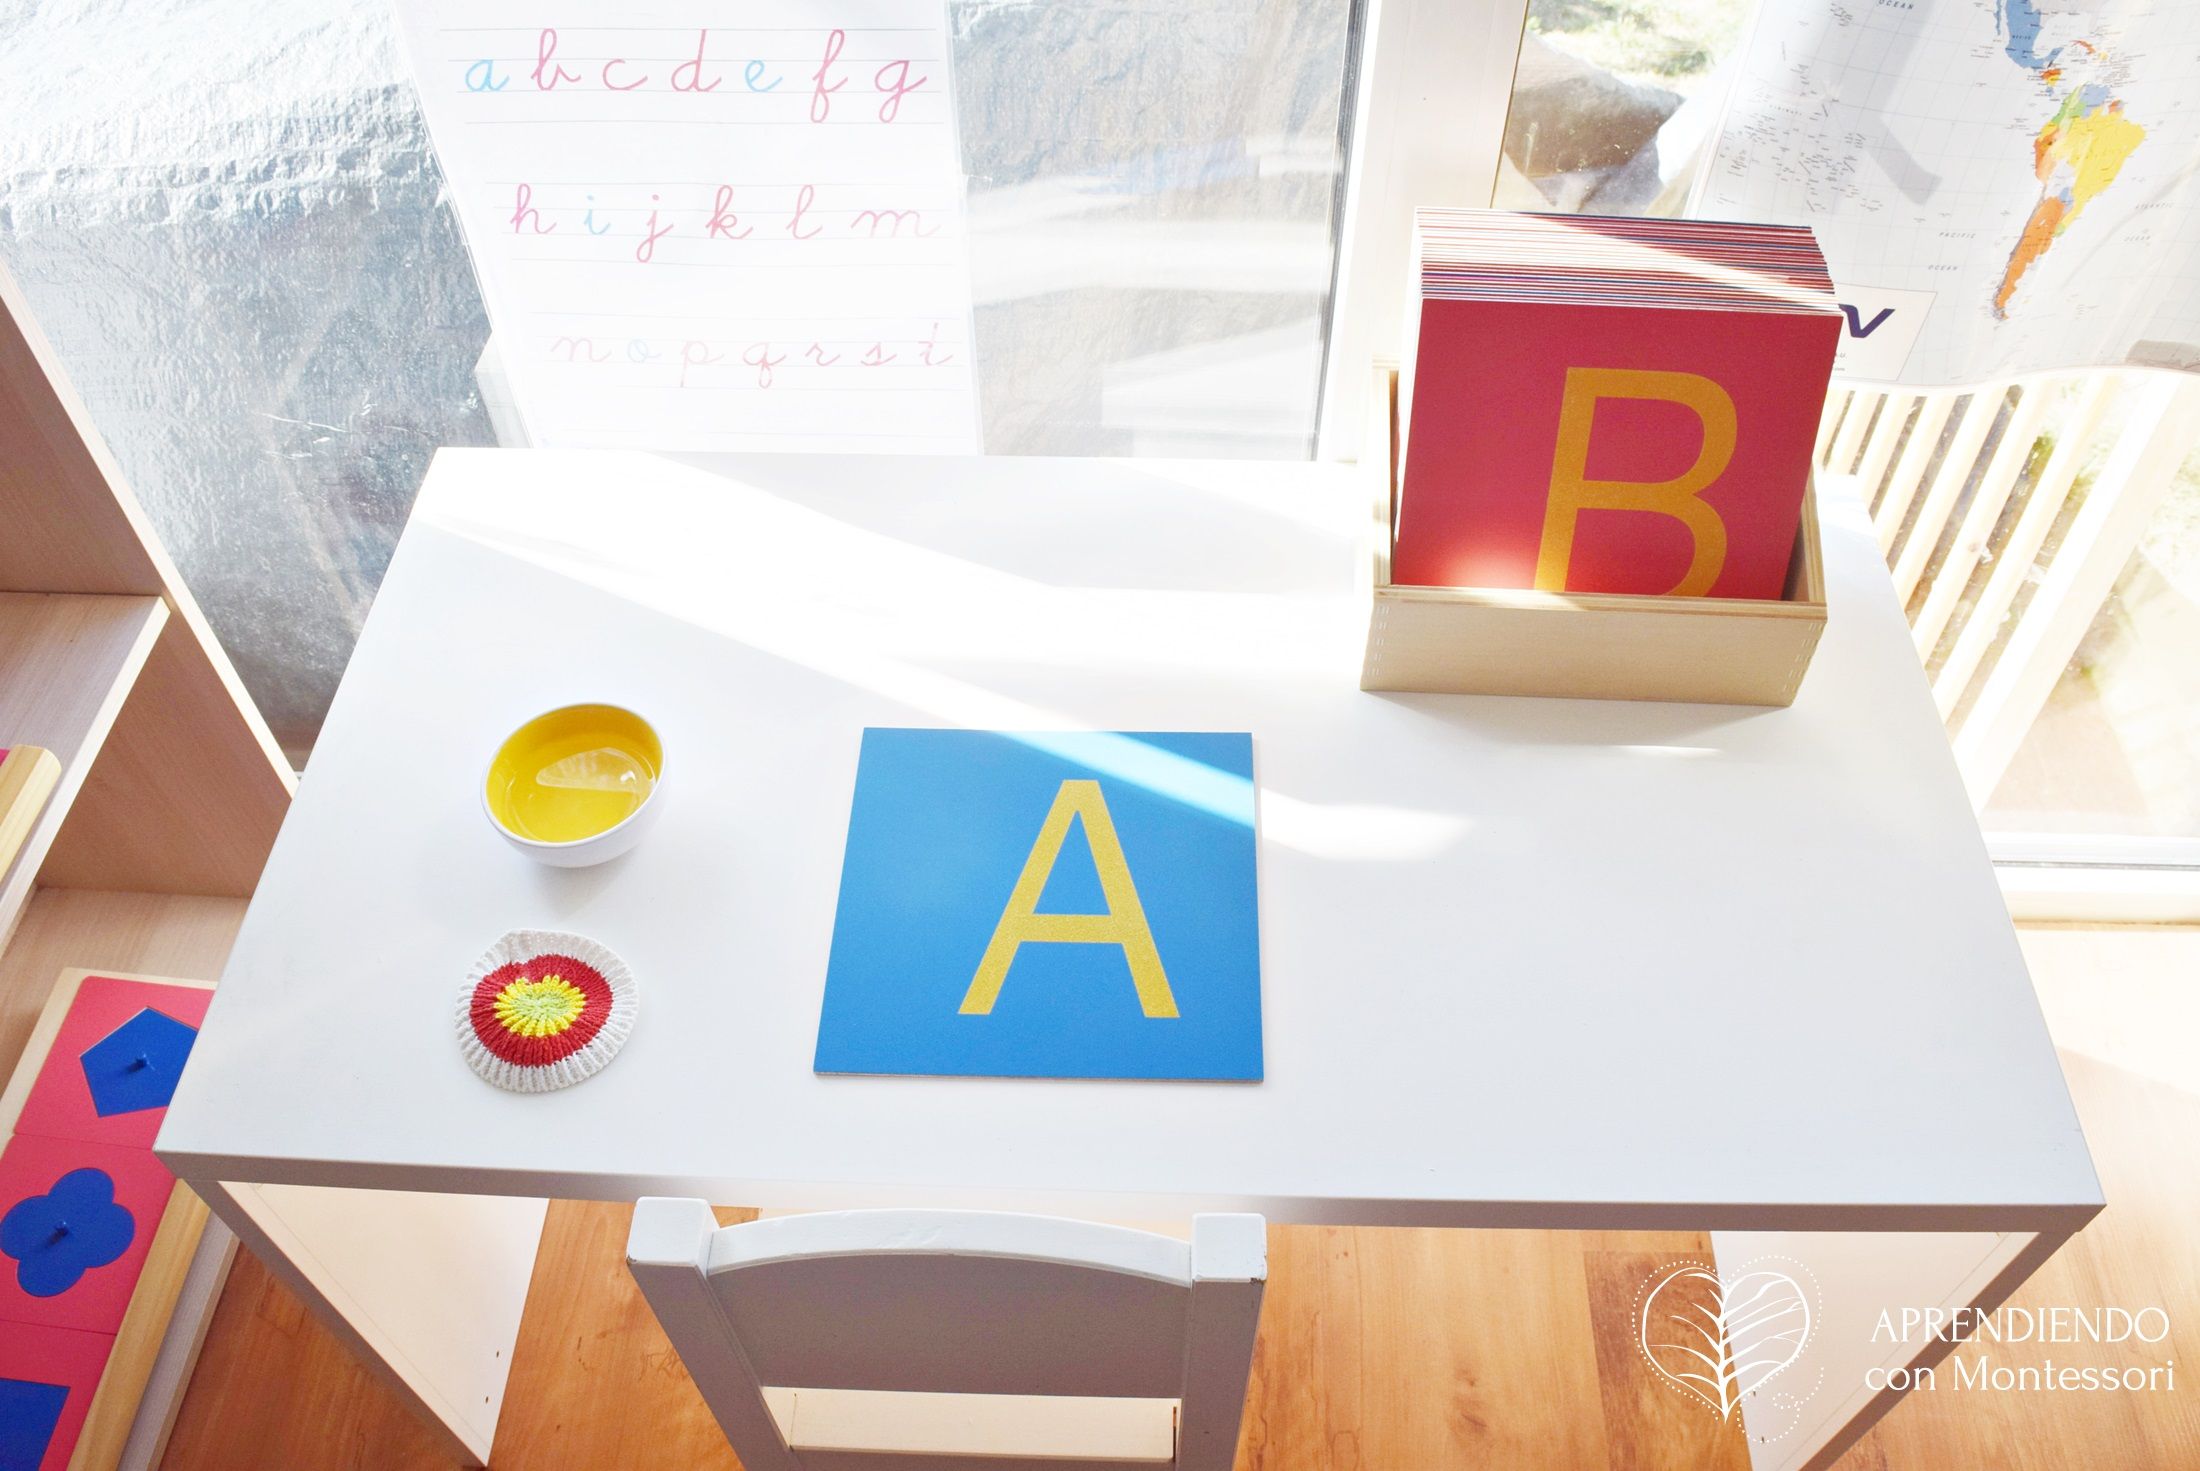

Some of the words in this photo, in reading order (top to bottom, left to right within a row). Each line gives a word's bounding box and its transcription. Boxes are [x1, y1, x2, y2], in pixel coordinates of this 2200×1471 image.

[465, 59, 509, 92] a
[530, 28, 581, 91] b
[602, 58, 648, 91] c
[670, 28, 721, 92] d
[744, 59, 783, 92] e
[810, 29, 848, 123] f
[874, 59, 927, 123] g
[510, 183, 557, 233] h
[583, 194, 610, 235] i
[636, 194, 674, 262] j
[706, 185, 753, 239] k
[786, 184, 822, 239] l
[851, 209, 940, 239] m
[550, 336, 612, 362] n
[627, 338, 662, 363] o
[680, 340, 724, 388] p
[742, 342, 787, 388] q
[805, 342, 841, 367] r
[860, 342, 897, 367] s
[918, 322, 953, 367] t
[1534, 367, 1737, 597] B
[957, 780, 1180, 1018] A
